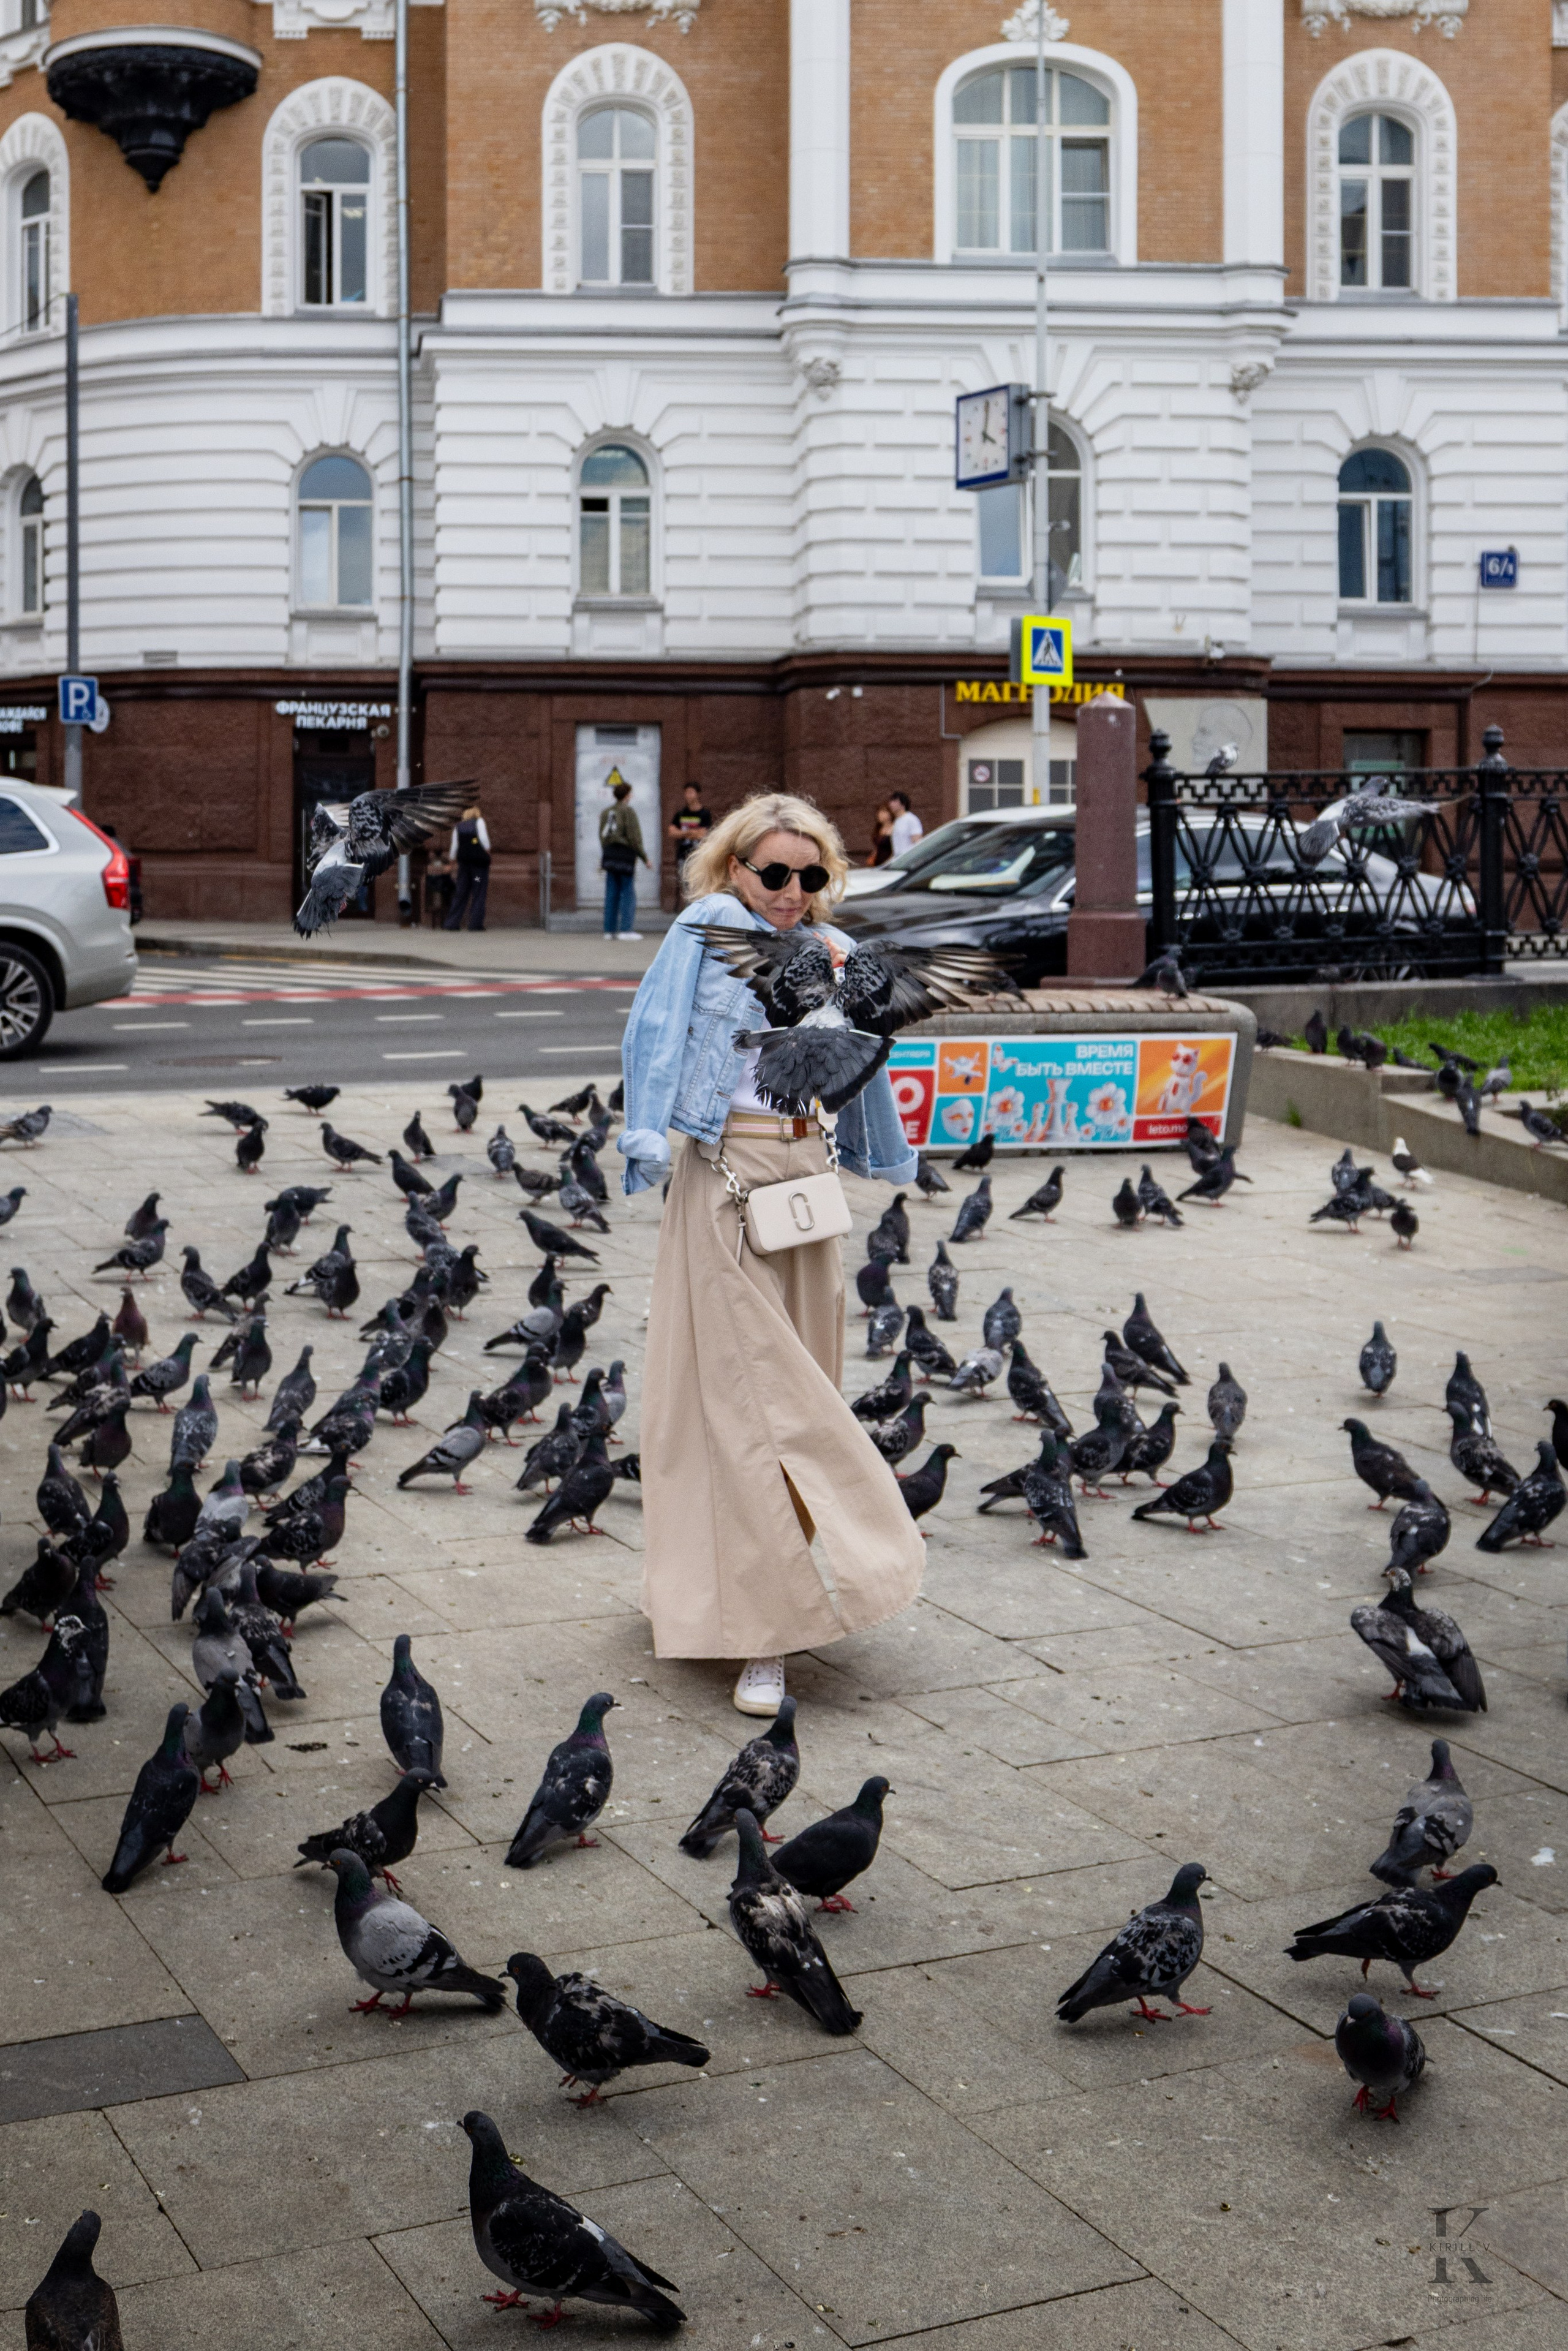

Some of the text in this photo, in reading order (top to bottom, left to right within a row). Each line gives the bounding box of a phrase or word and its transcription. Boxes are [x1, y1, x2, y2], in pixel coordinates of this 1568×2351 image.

[69, 682, 90, 718] P
[276, 700, 391, 717] ФРАНЦУЗСКАЯ
[296, 715, 367, 730] ПЕКАРНЯ
[1076, 1044, 1133, 1059] ВРЕМЯ
[1016, 1061, 1133, 1077] БЫТЬ ВМЕСТЕ
[1149, 1125, 1188, 1134] leto.mo
